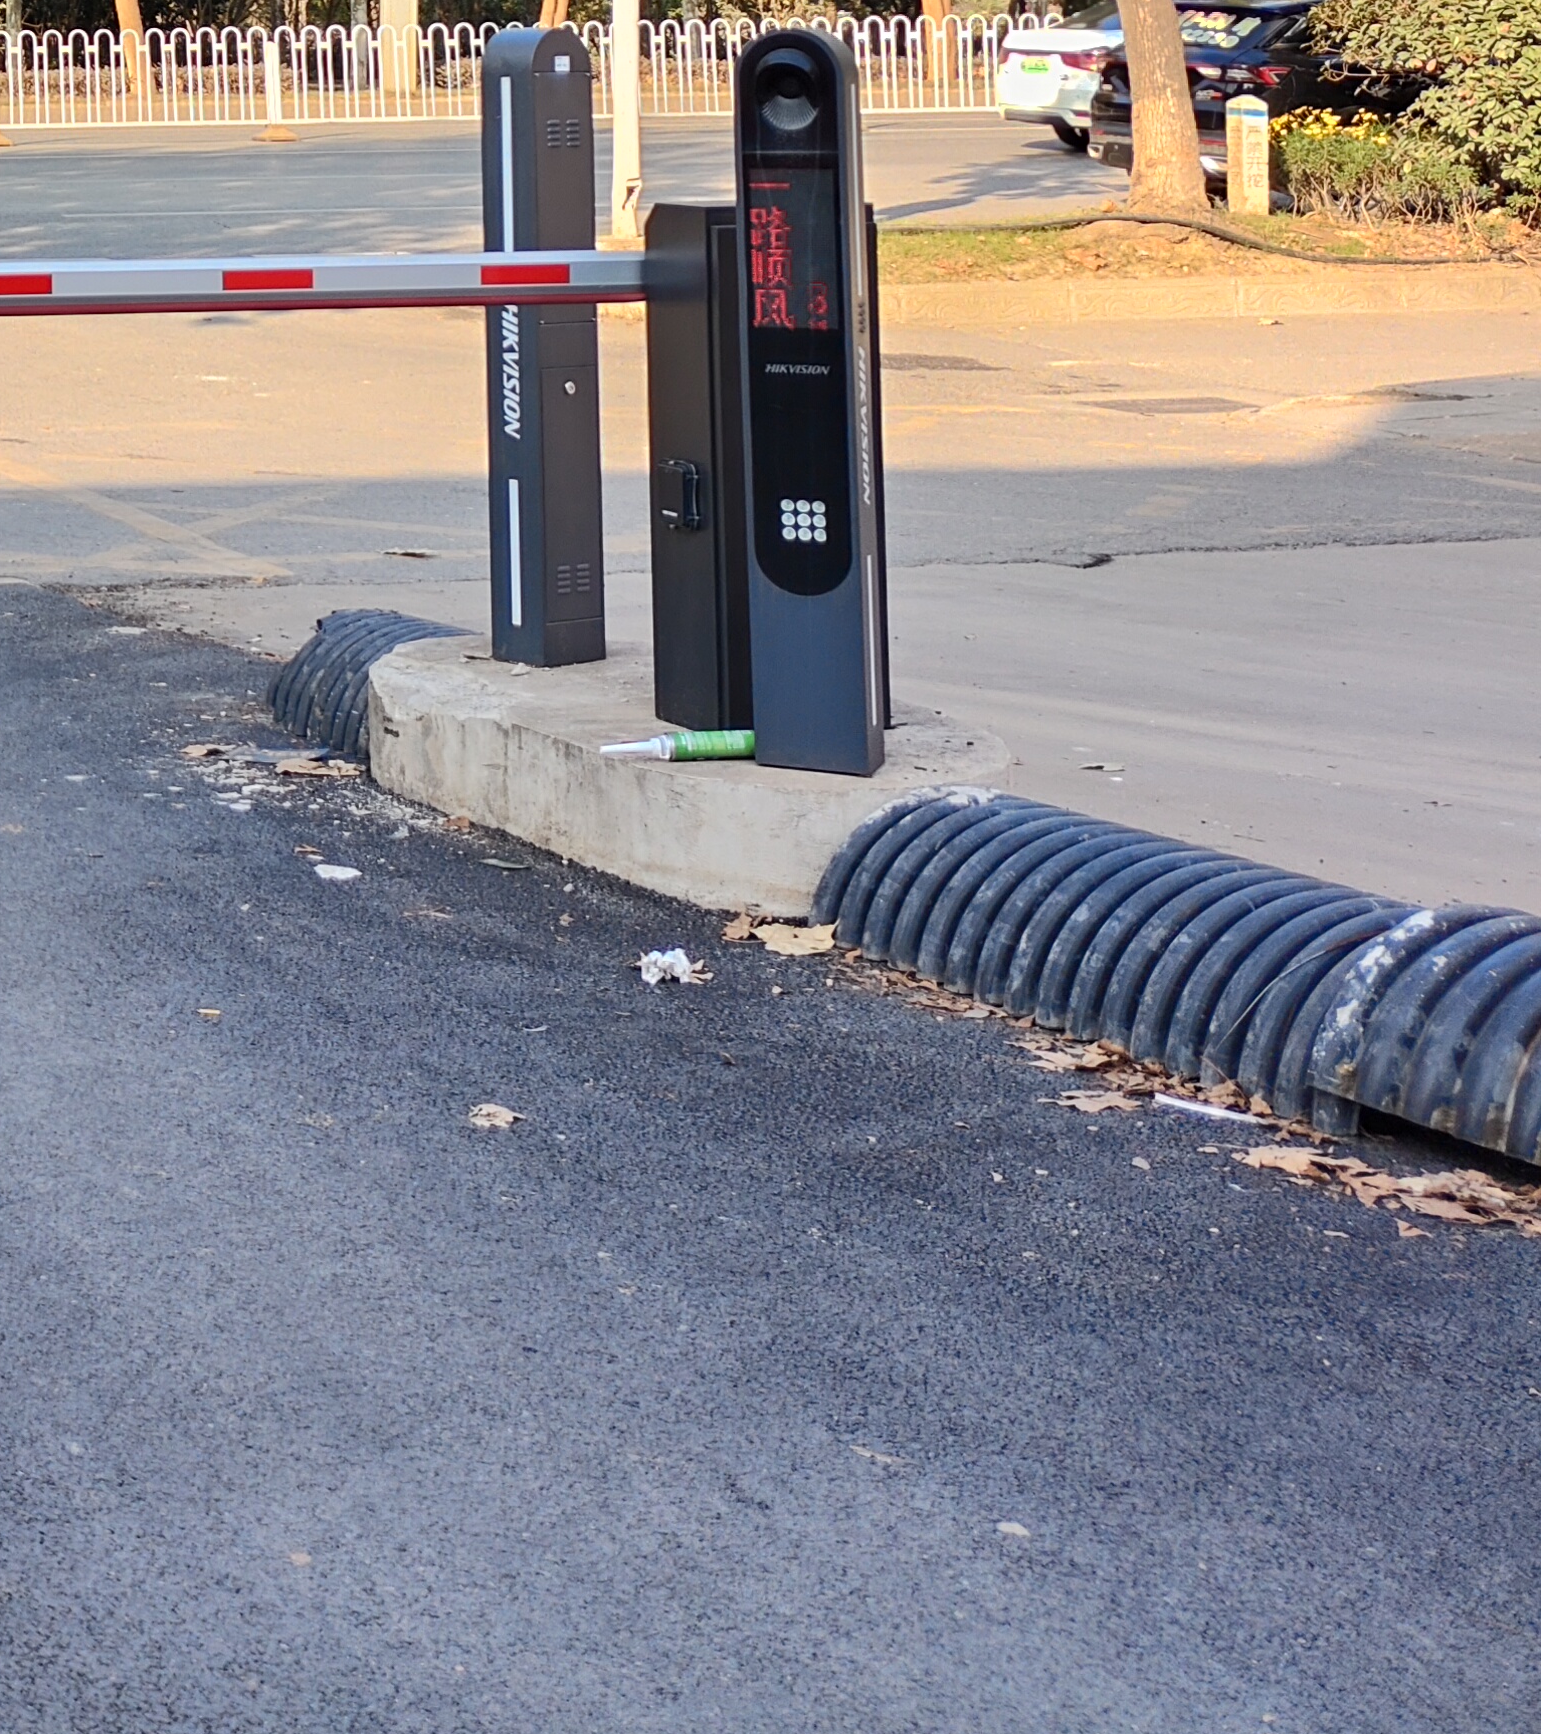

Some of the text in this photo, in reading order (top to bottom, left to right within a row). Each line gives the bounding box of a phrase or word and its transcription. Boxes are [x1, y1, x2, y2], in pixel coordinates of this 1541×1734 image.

[749, 181, 797, 331] 一路顺风
[501, 304, 521, 440] HIKVISION
[764, 363, 831, 376] HIKVISION
[857, 346, 871, 505] HIKVISION
